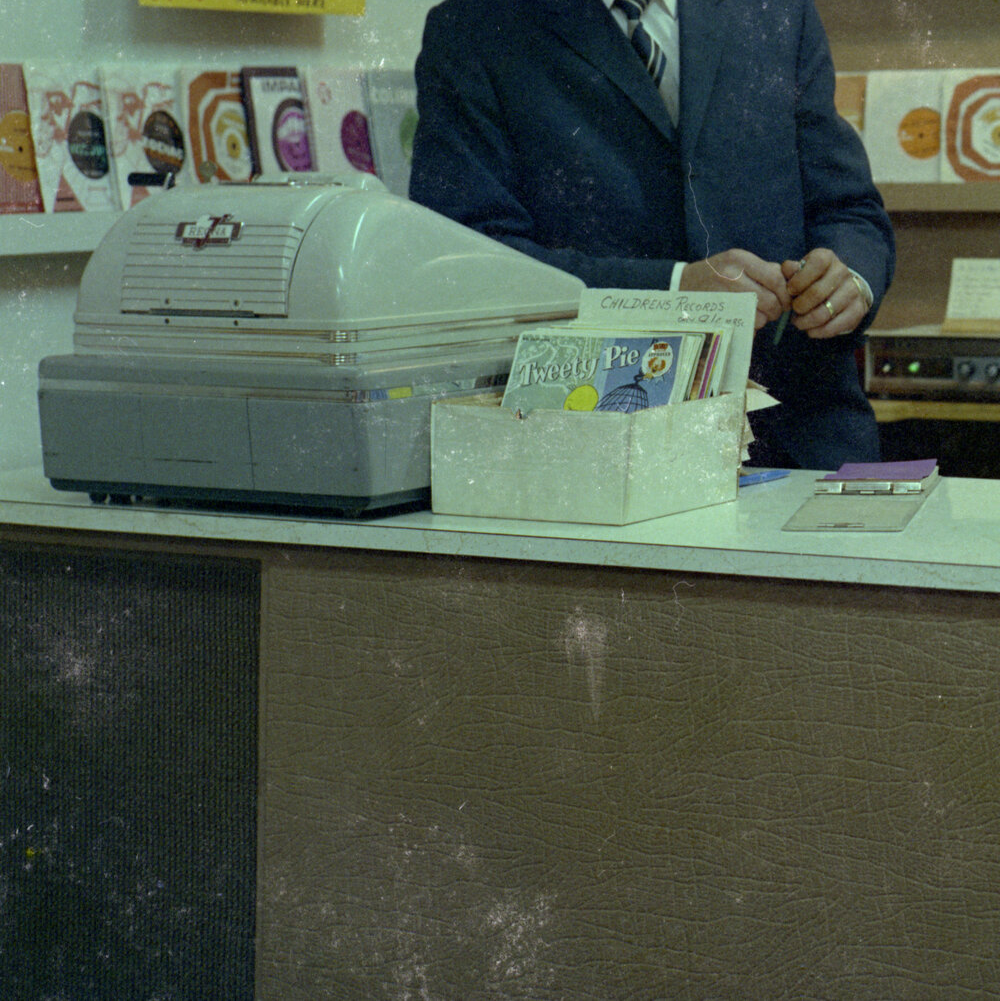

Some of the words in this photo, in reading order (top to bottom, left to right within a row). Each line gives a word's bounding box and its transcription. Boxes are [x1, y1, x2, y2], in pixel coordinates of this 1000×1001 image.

[600, 295, 672, 311] CHILDRENS
[518, 357, 600, 387] Tweety
[602, 344, 642, 371] Pie
